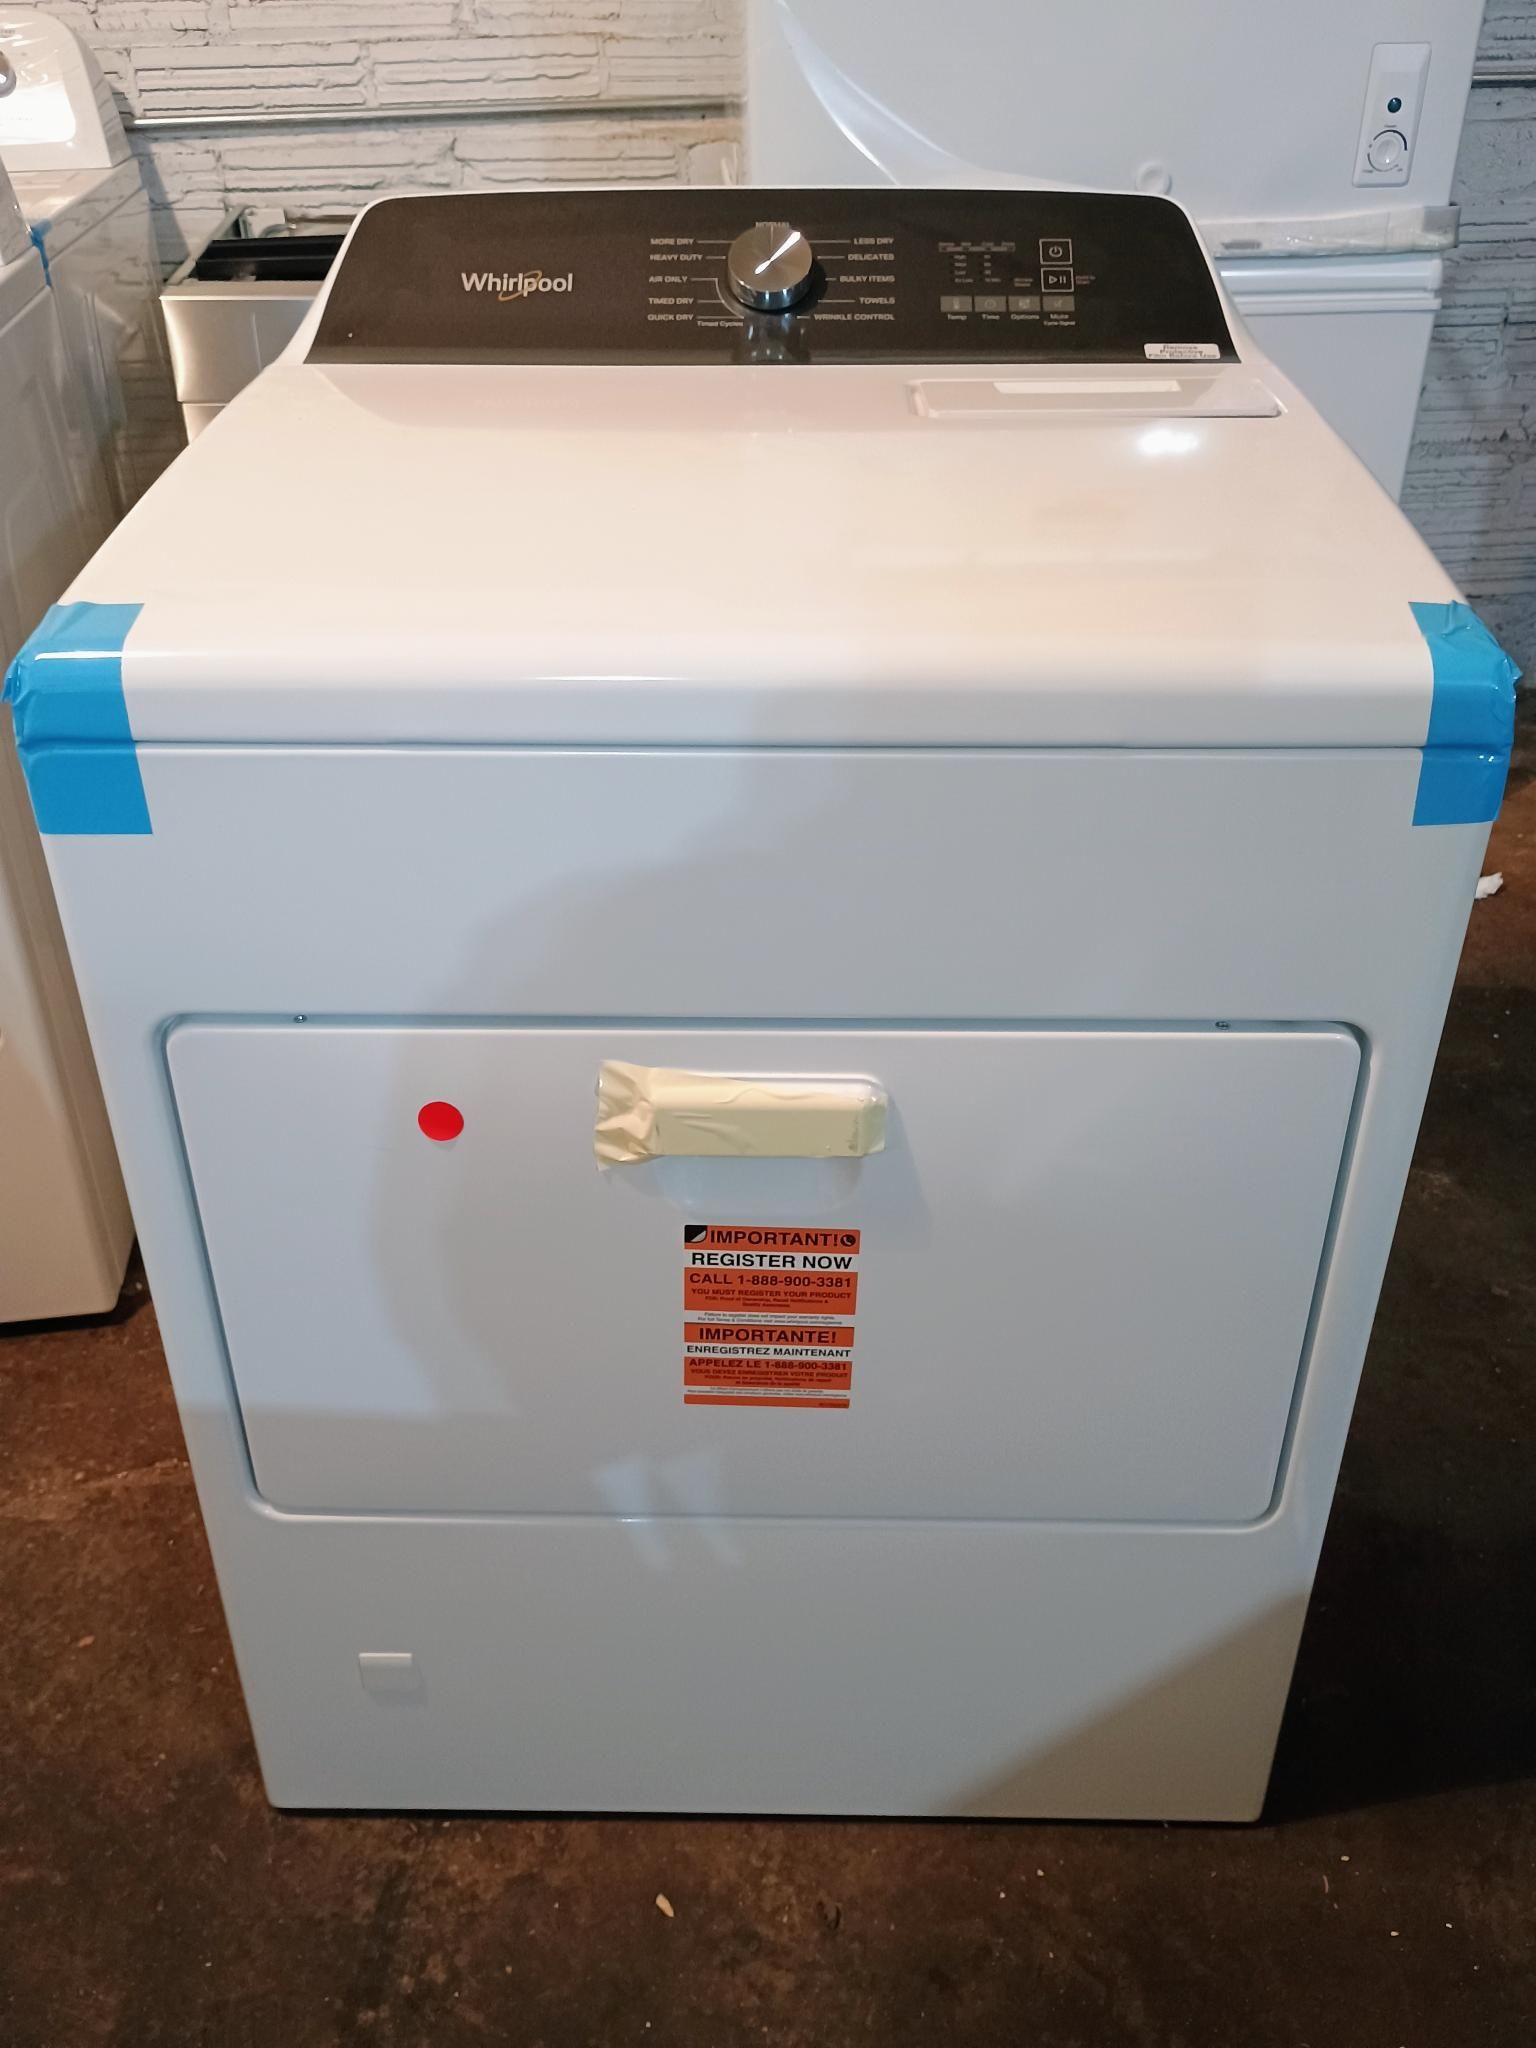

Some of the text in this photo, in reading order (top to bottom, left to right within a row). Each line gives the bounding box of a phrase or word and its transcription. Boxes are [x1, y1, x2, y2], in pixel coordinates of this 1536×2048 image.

[853, 237, 894, 245] LESS DRY
[847, 253, 895, 261] DELICATES
[648, 275, 688, 283] AIR ONLY
[840, 275, 896, 283] BULKY ITEMS
[461, 272, 573, 297] Whirlpool
[648, 297, 694, 305] TIMED DRY
[859, 297, 896, 305] TOWELS
[813, 313, 895, 321] WRINKLE CONTROL
[1011, 313, 1040, 321] Options
[710, 1229, 838, 1247] IMPORTANT!
[692, 1252, 853, 1270] REGISTER NOW
[689, 1273, 851, 1288] CALL 1-888-900-3381
[738, 1289, 781, 1297] REGISTER
[809, 1291, 851, 1299] PRODUCT
[699, 1327, 837, 1344] IMPORTANTE!
[687, 1345, 851, 1358] ENREGISTREZ MAINTENANT
[689, 1358, 847, 1371] APPELEZ LE 1-888-900-3381
